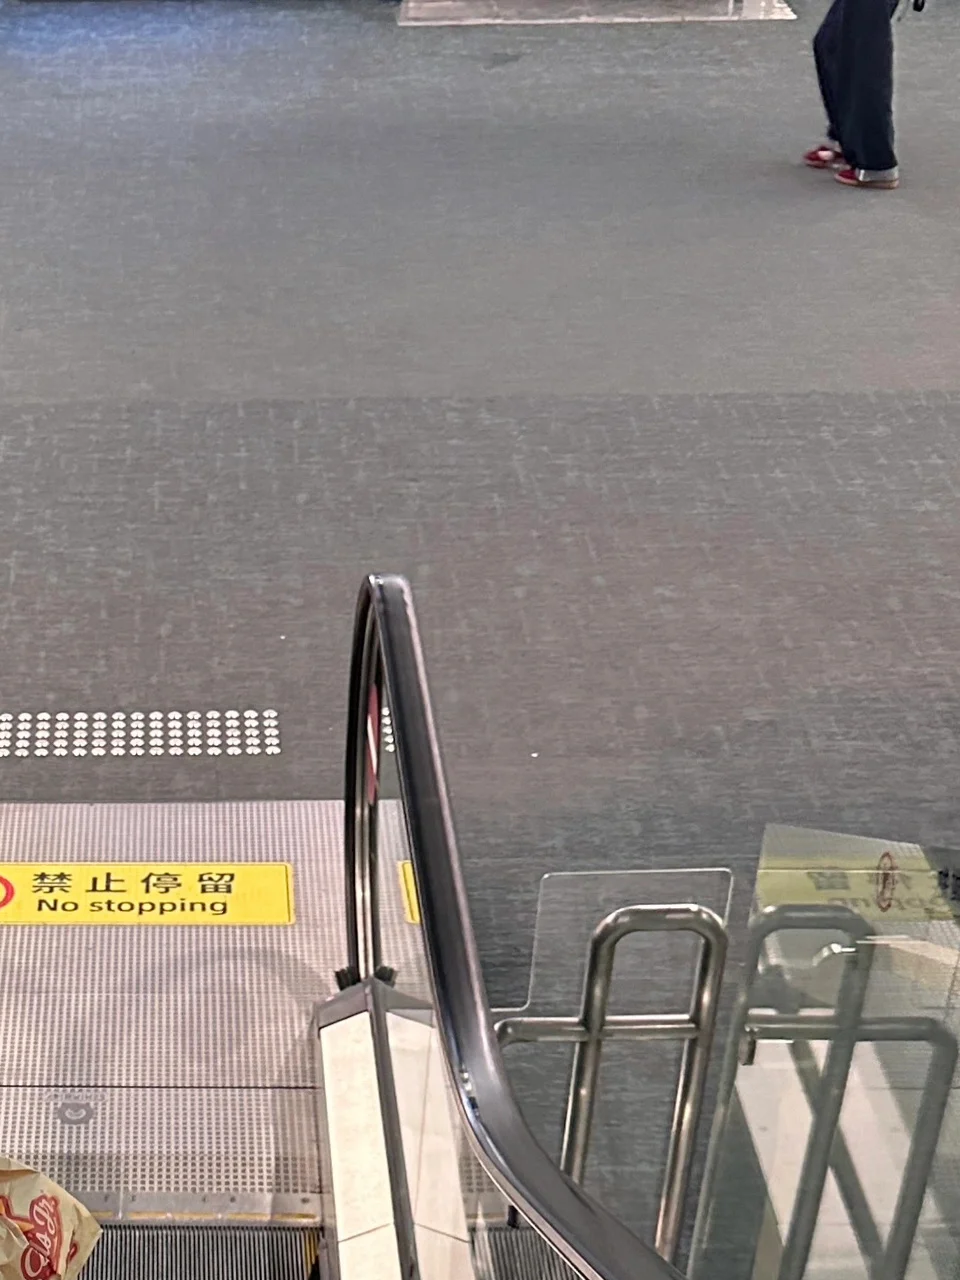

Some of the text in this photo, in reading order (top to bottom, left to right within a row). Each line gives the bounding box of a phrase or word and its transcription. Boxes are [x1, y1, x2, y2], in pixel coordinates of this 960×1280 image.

[32, 872, 235, 894] 禁止停留
[37, 898, 228, 915] No stopping
